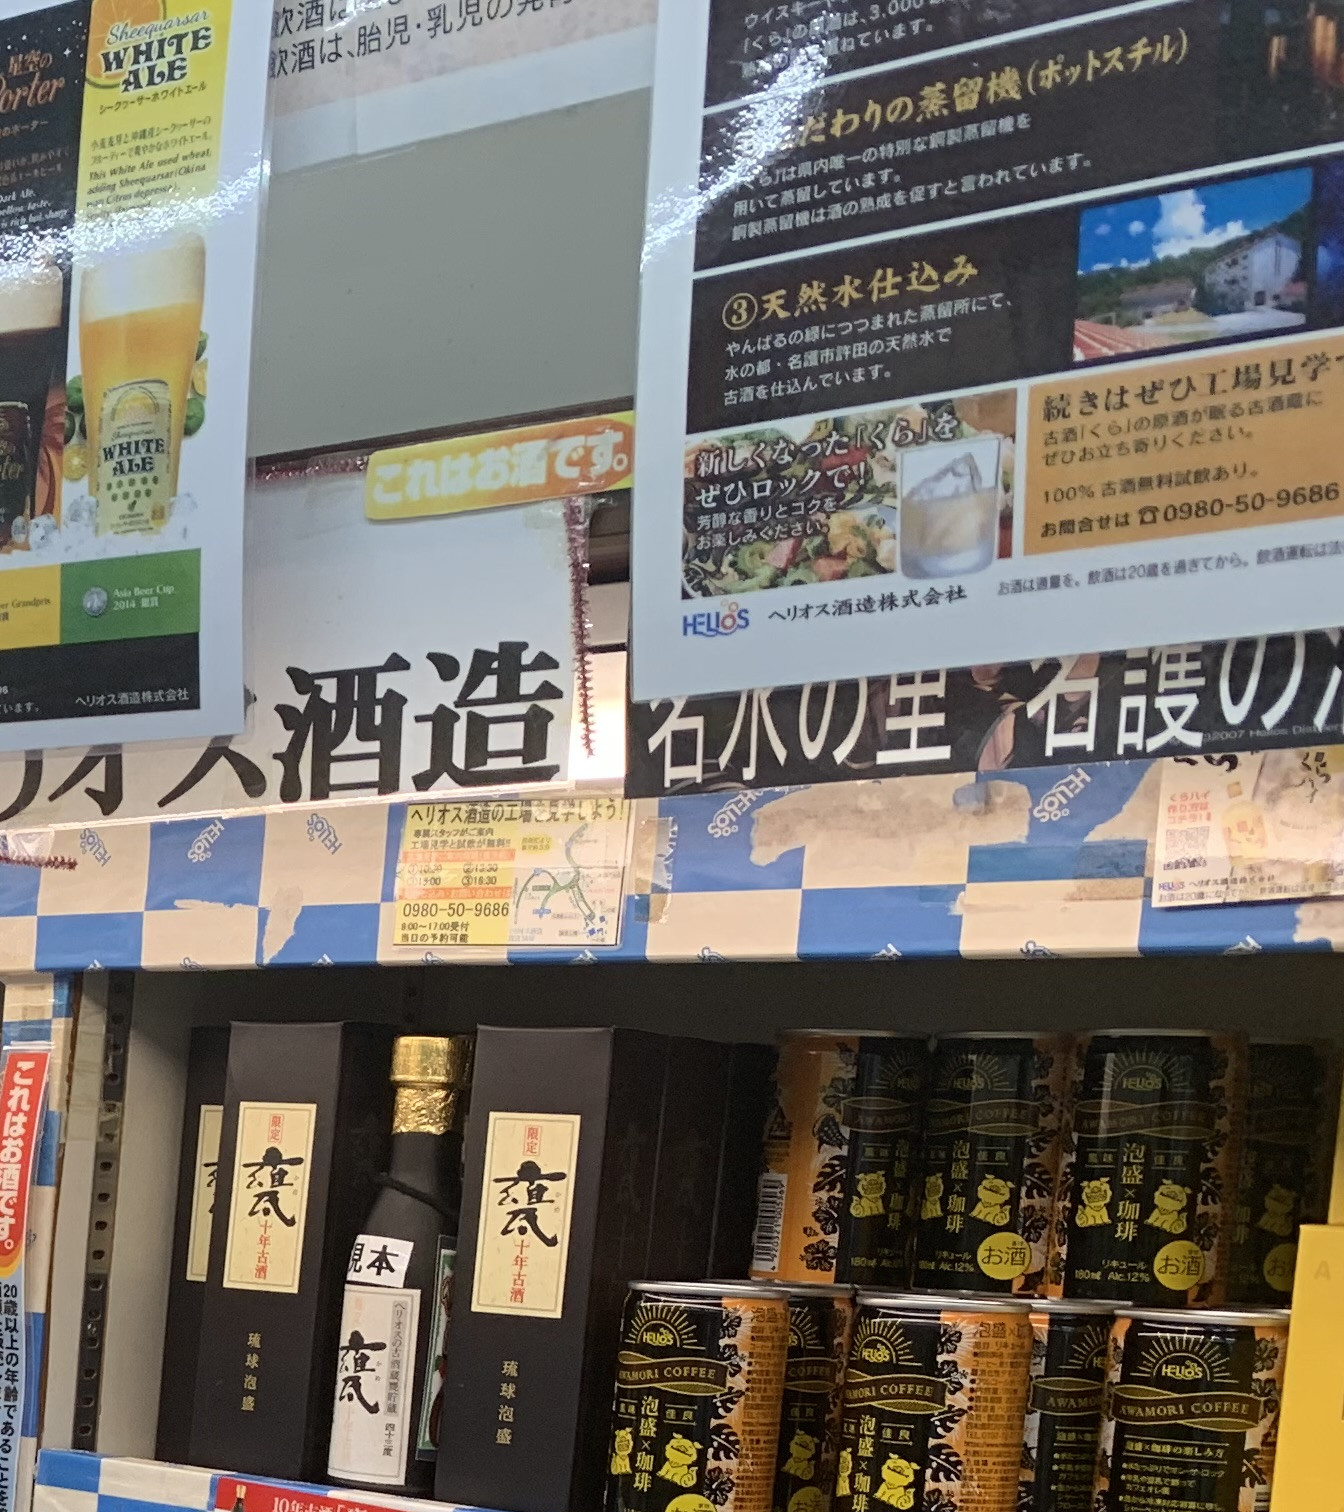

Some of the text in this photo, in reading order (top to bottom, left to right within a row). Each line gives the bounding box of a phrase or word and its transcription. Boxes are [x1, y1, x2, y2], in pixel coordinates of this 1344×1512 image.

[101, 27, 212, 73] WHITE
[122, 58, 188, 93] ALE
[372, 429, 628, 503] これはお酒です。
[1044, 483, 1095, 503] 100%
[768, 584, 967, 621] ヘリオス酒造株式会社
[240, 1332, 262, 1413] 琉球泡盛
[495, 1360, 520, 1446] 琉球泡盛
